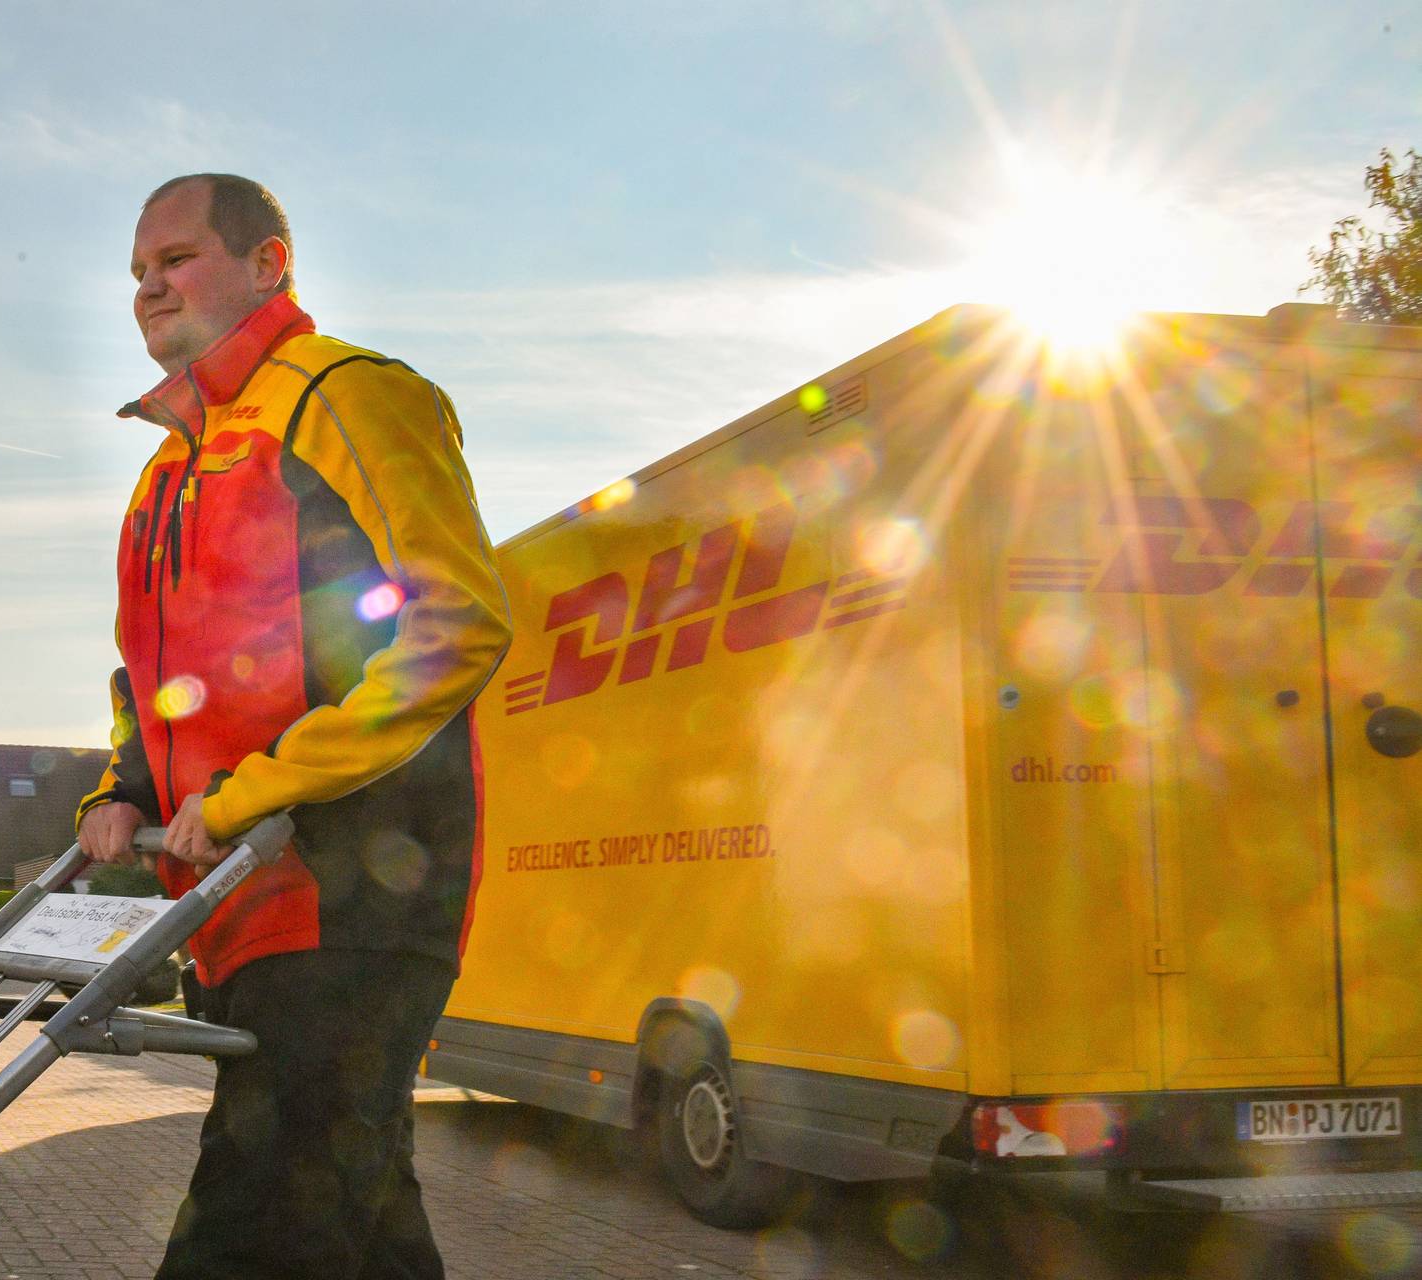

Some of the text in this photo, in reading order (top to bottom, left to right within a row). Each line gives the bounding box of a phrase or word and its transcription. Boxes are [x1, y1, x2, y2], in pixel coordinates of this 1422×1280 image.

[1092, 496, 1422, 599] DH
[543, 496, 831, 707] DHL
[1012, 757, 1116, 782] dhl.com
[507, 824, 776, 873] EXCELLENCE. SIMPLY DELIVERED.
[82, 909, 108, 922] Post
[1252, 1102, 1397, 1136] BN PJ 7071
